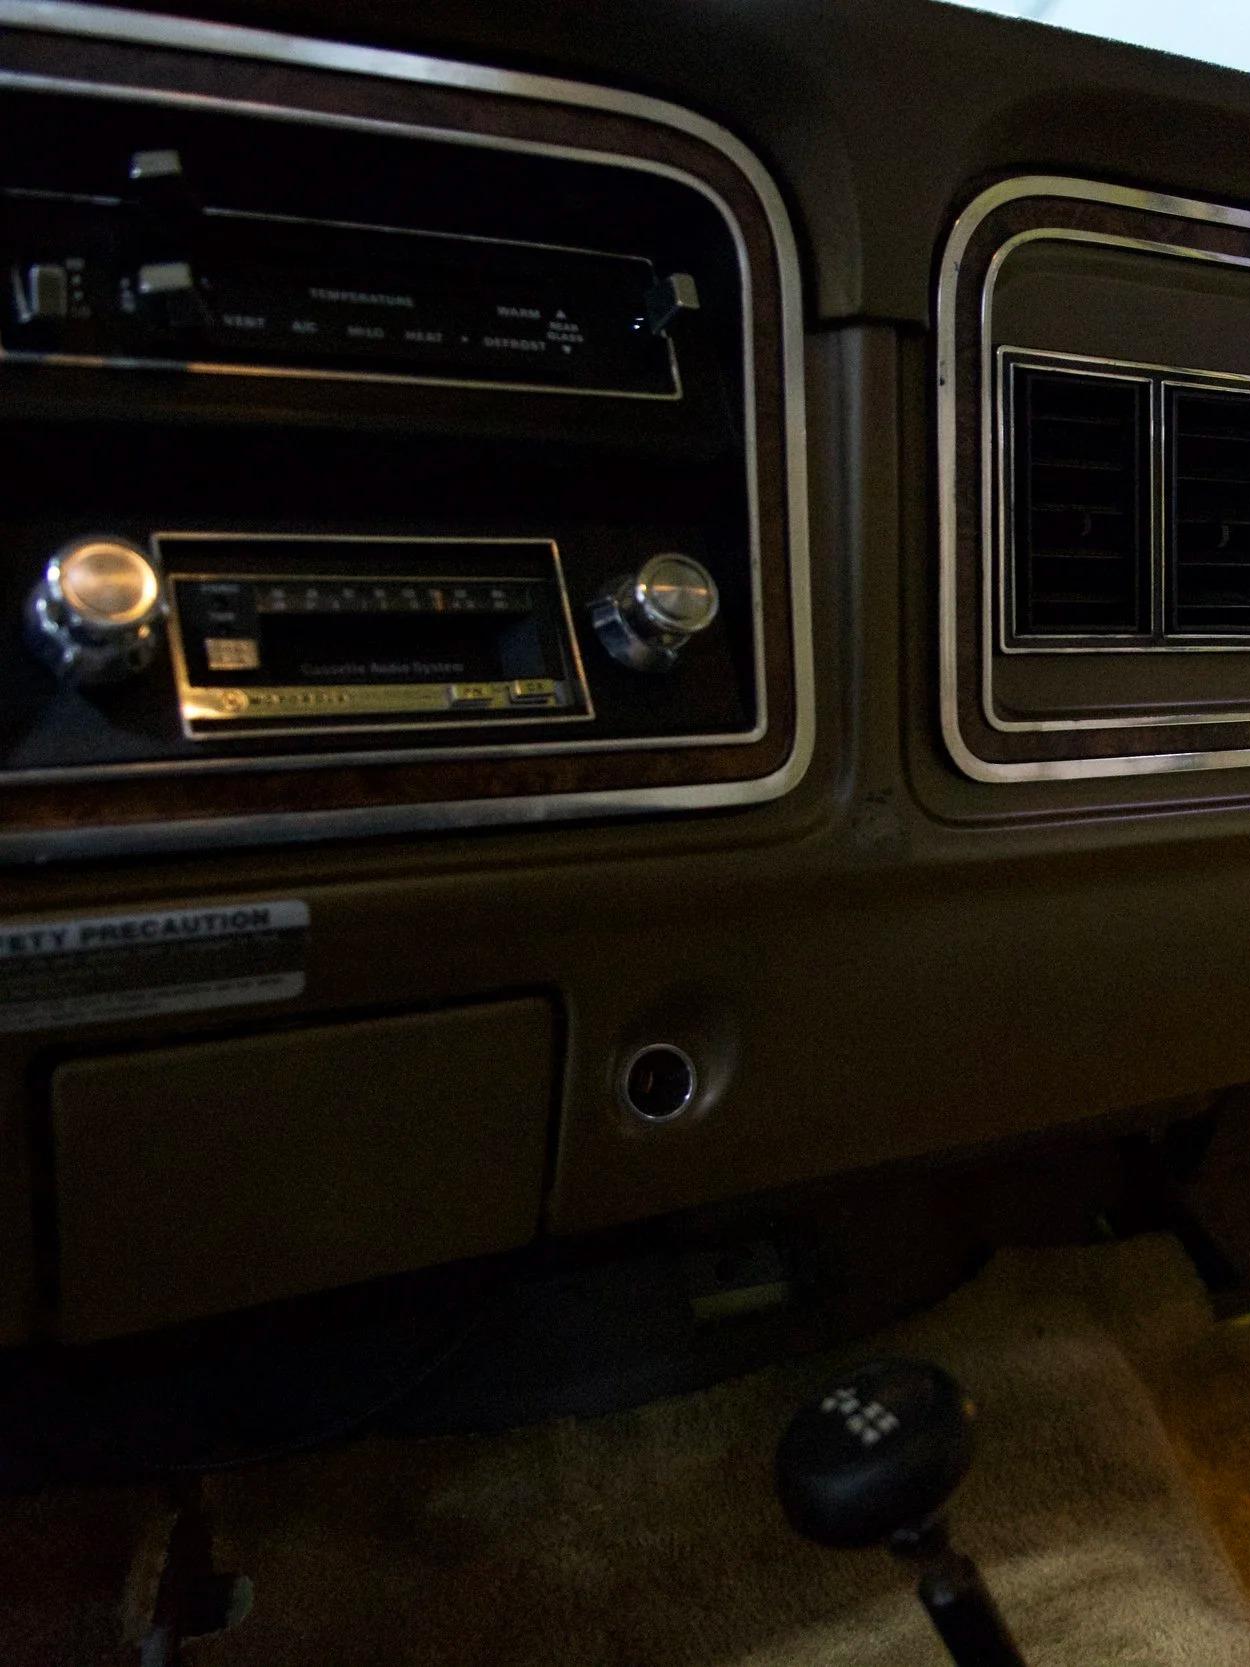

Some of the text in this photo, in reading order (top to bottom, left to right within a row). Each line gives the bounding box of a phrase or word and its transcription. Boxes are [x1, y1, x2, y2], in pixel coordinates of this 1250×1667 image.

[307, 287, 416, 309] TEMPERATURE
[496, 305, 542, 321] WARM
[404, 330, 444, 344] HEAT
[483, 336, 547, 352] DEFROST
[80, 908, 271, 945] PRECAUTION
